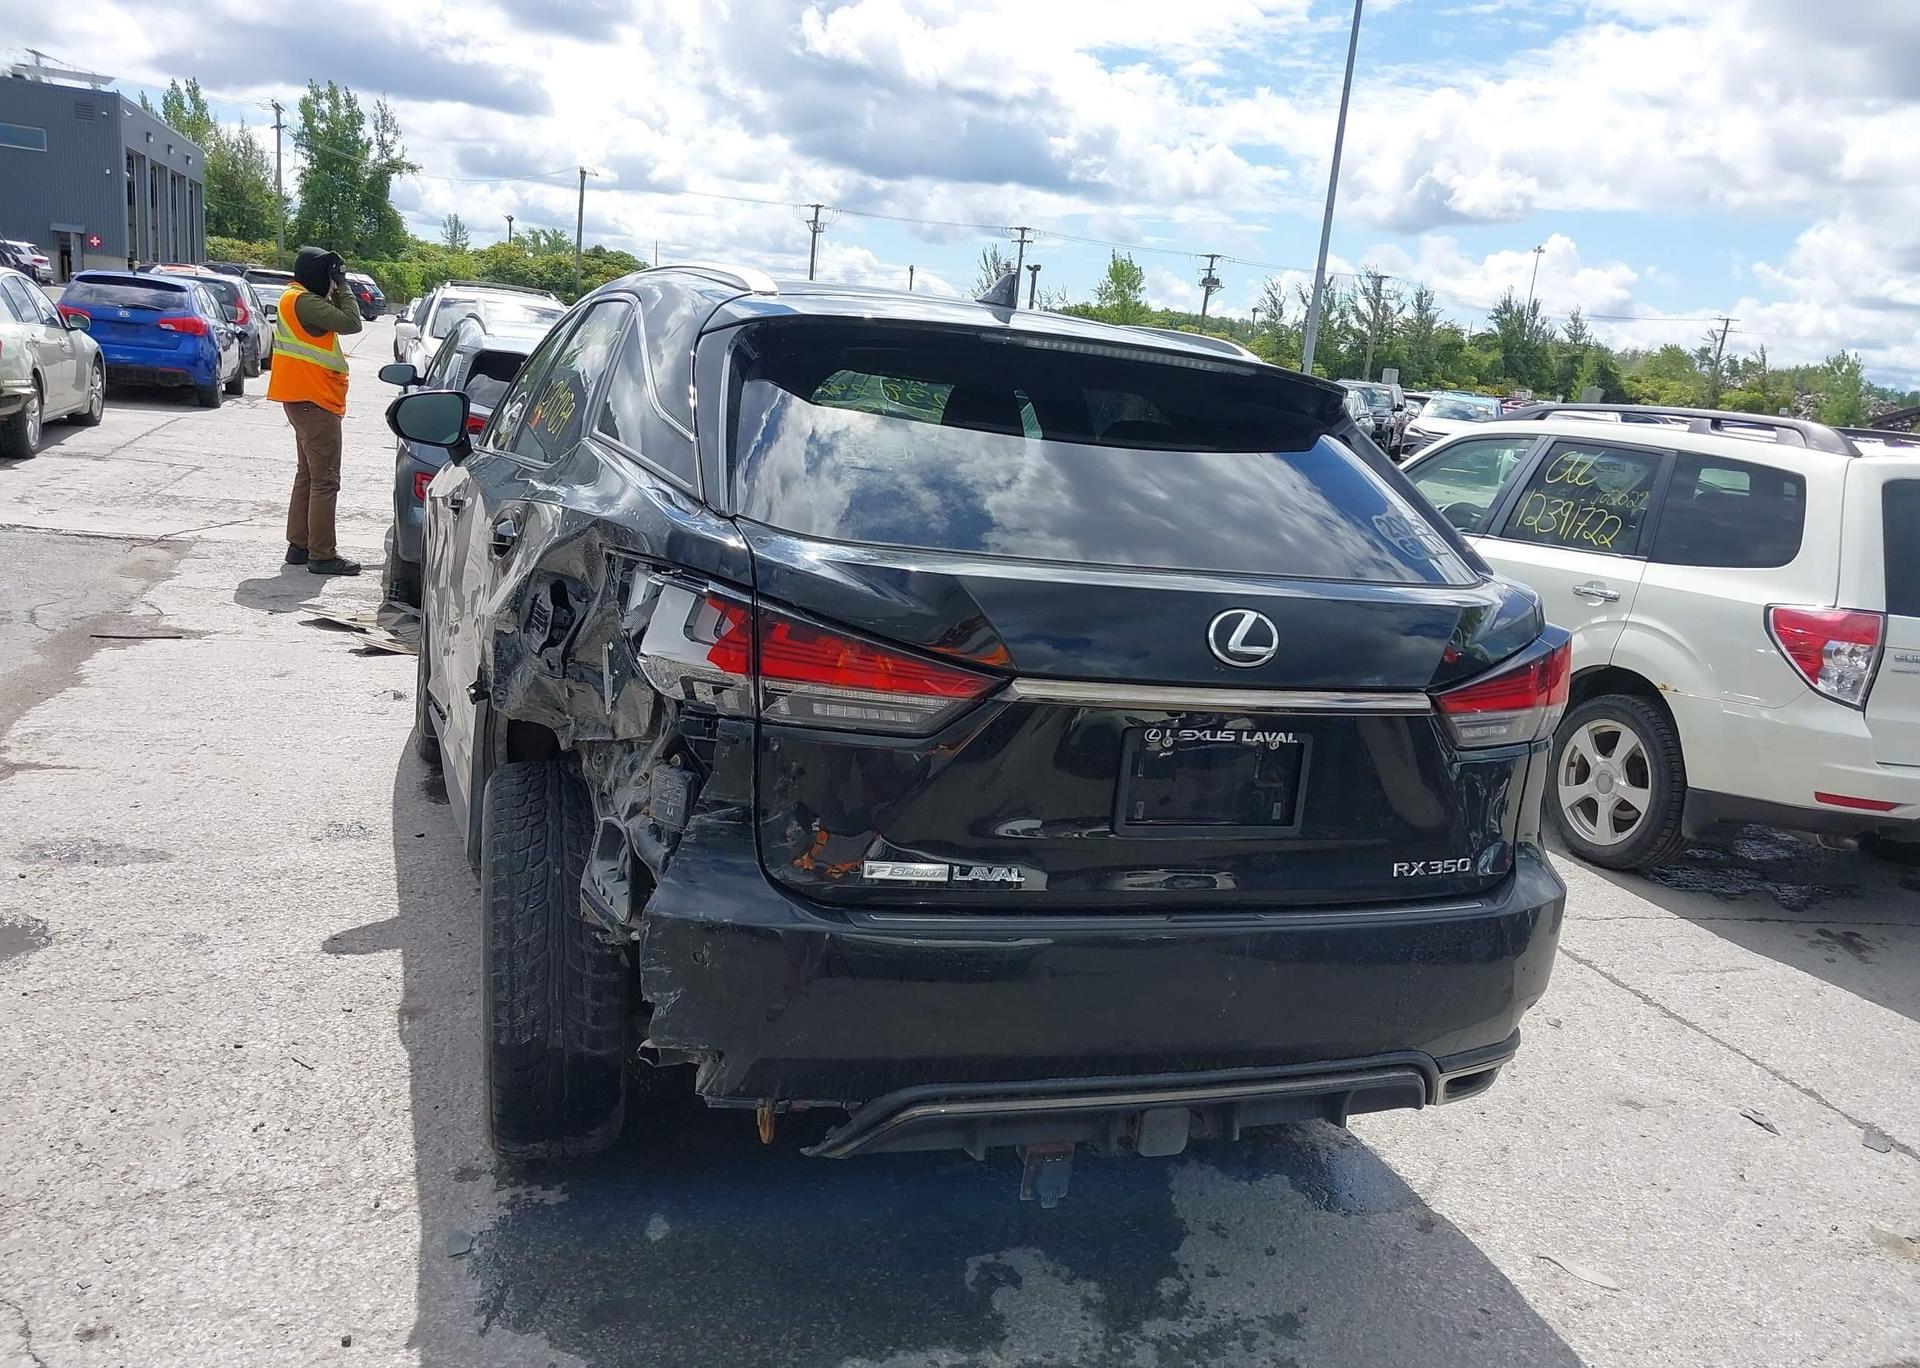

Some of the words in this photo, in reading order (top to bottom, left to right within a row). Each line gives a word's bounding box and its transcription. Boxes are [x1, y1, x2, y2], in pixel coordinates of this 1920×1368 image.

[1241, 731, 1298, 744] LAVAL
[892, 866, 944, 878] SPORT
[952, 865, 1026, 882] LAVAL
[1392, 861, 1426, 877] RX
[1428, 858, 1471, 875] 350
